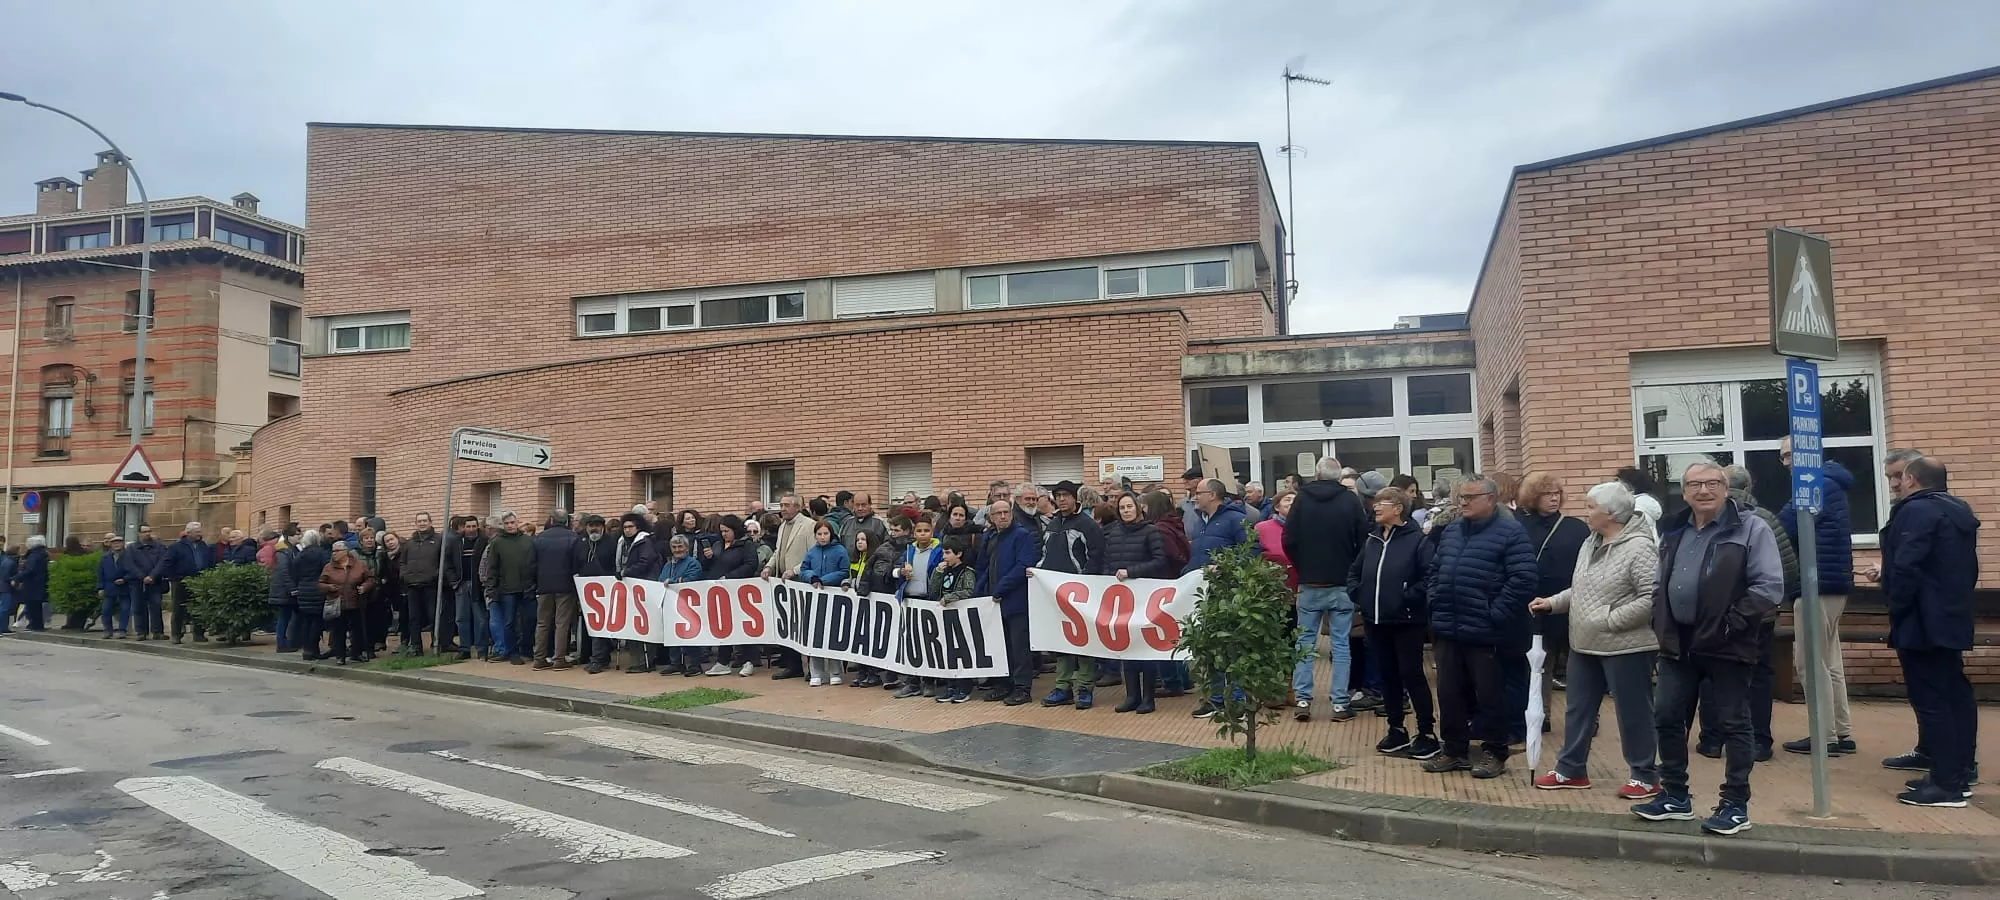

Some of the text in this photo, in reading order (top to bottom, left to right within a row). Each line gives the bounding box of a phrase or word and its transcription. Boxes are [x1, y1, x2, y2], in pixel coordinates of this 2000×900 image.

[1794, 373, 1808, 404] P
[1793, 416, 1818, 432] PARKING
[462, 439, 497, 449] servicios
[461, 448, 493, 458] médicos
[1793, 452, 1821, 469] GRATUITO
[1798, 487, 1810, 498] 500
[583, 581, 650, 636] SOS
[1055, 581, 1181, 652] SOS
[675, 584, 994, 670] SOS SANIDAD RURAL
